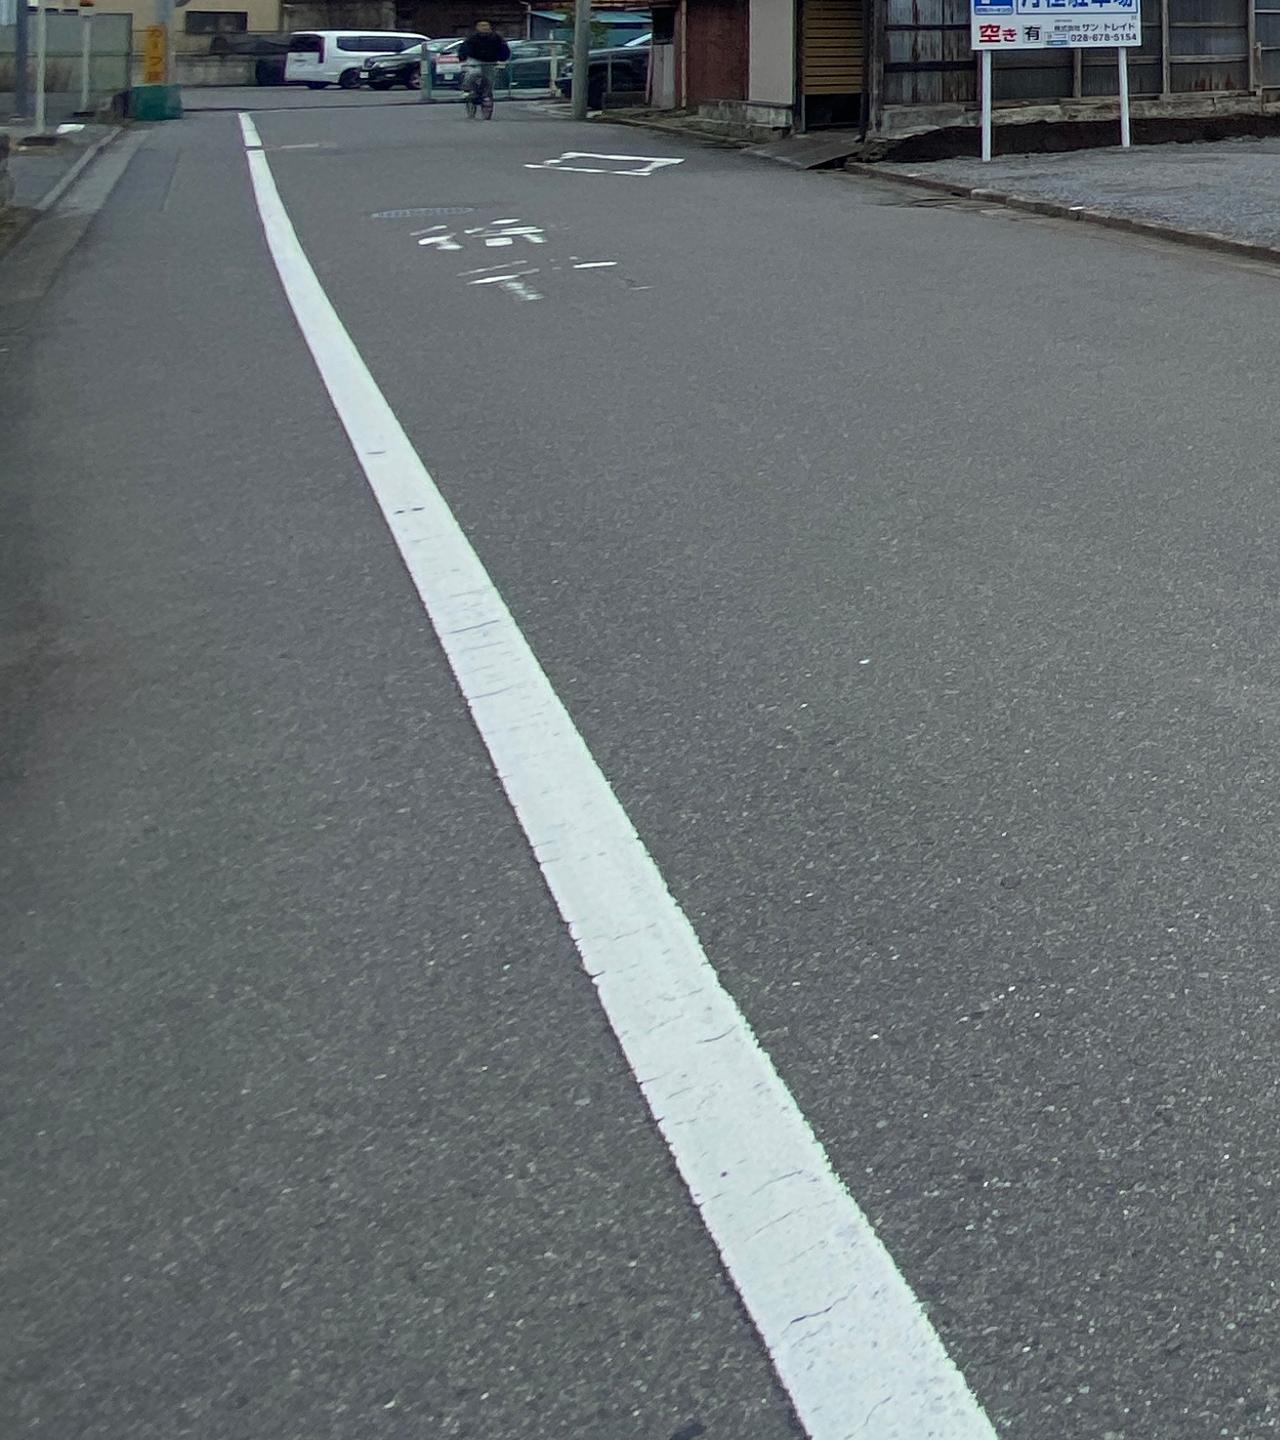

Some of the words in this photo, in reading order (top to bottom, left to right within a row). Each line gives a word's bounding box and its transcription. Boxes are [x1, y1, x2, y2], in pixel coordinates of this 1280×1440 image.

[979, 24, 1017, 43] 空き
[1024, 26, 1041, 41] 有
[1071, 33, 1137, 42] 028-678-5154
